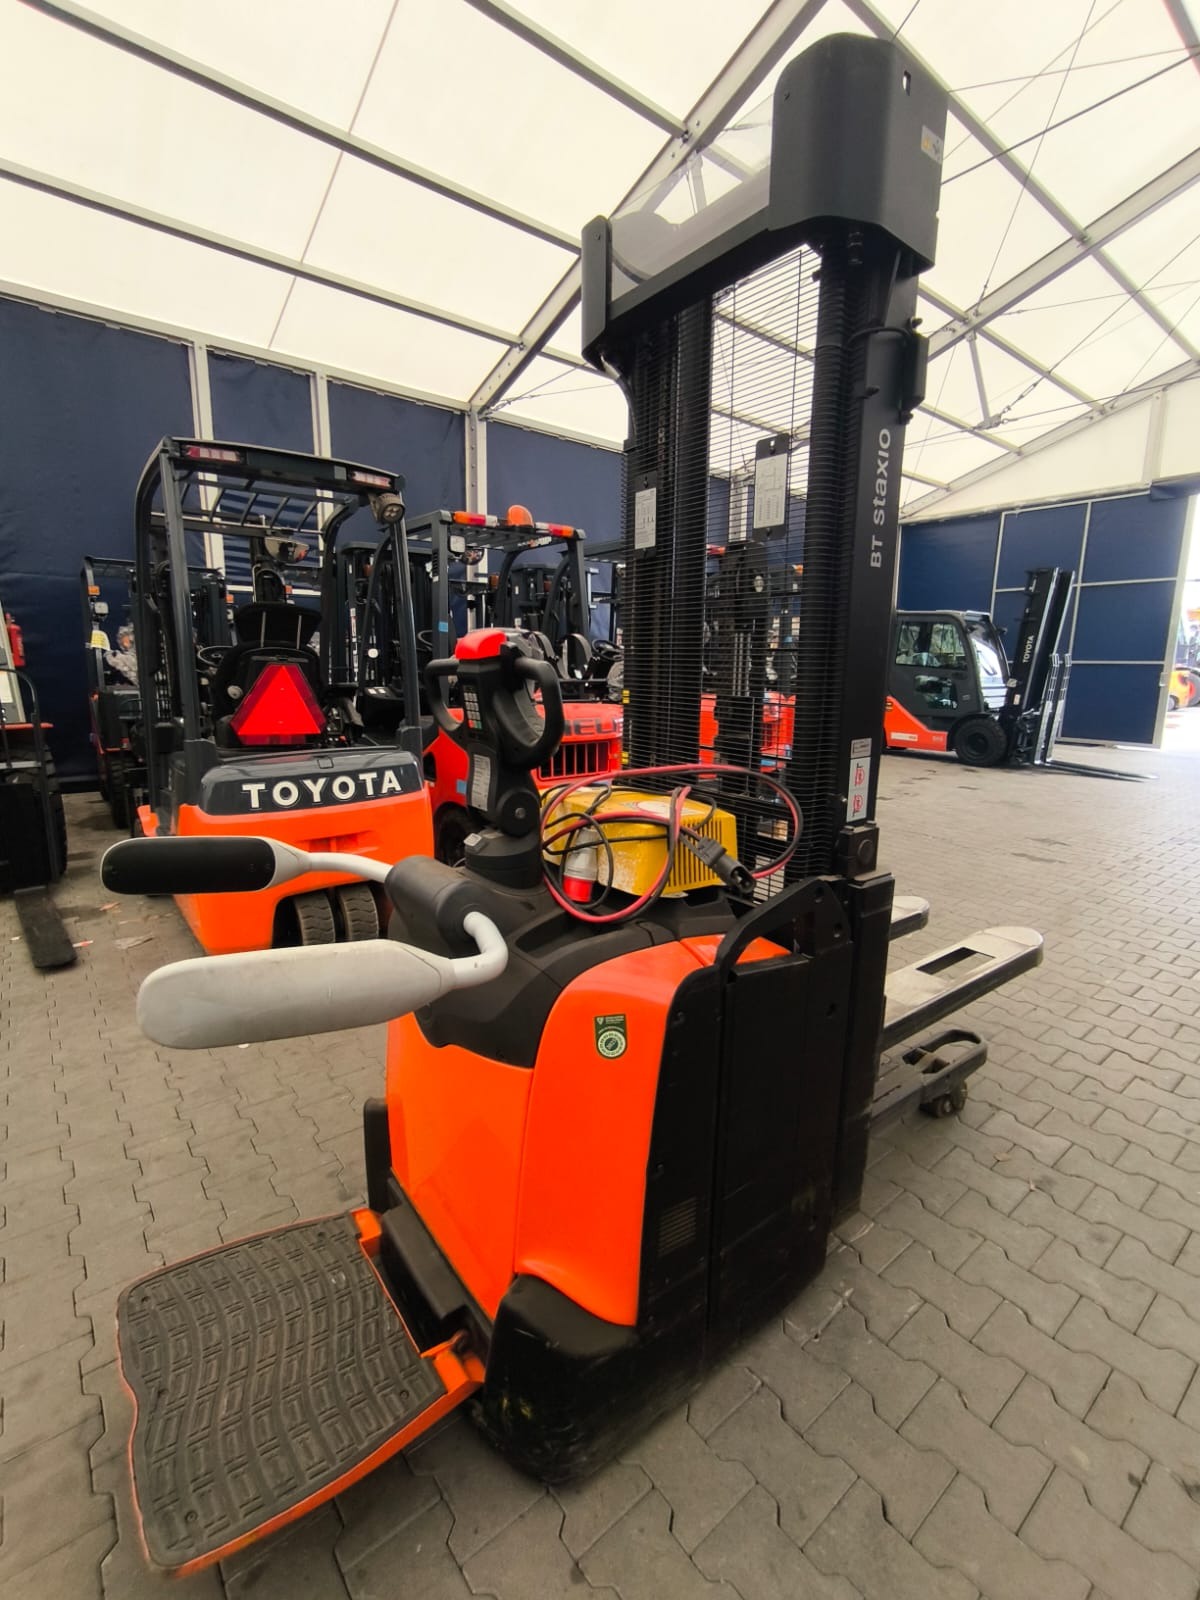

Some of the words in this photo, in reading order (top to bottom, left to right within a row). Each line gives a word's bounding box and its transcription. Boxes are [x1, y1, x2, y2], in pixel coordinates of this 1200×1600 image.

[870, 535, 883, 568] BT
[1022, 635, 1035, 663] TOYOTA
[241, 769, 402, 809] TOYOTA
